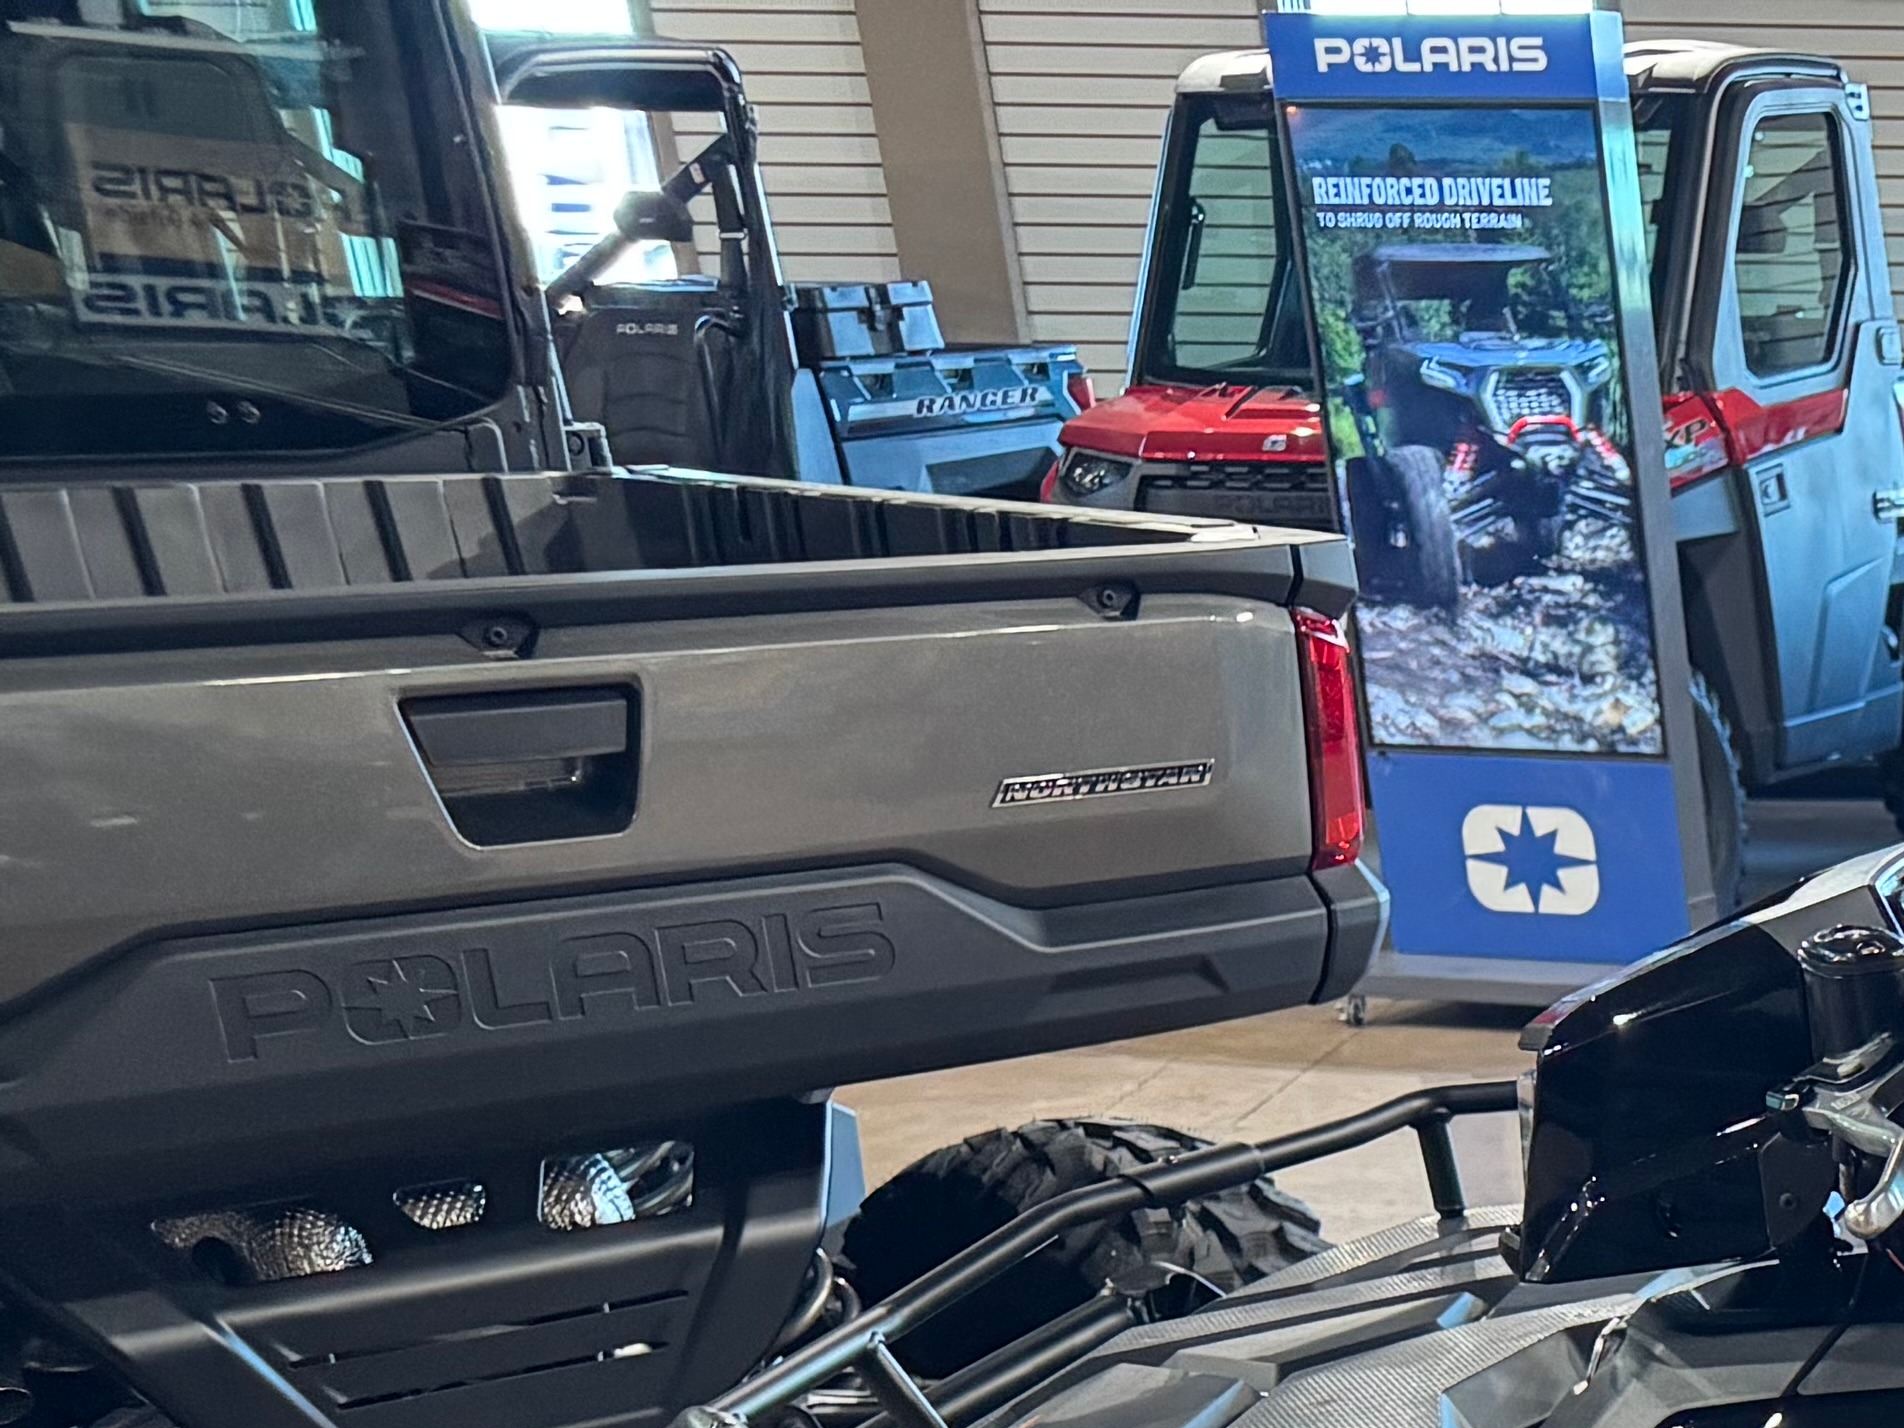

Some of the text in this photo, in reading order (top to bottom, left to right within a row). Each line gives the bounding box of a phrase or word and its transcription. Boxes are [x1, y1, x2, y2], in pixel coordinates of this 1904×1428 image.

[1315, 35, 1547, 73] POLARIS
[1312, 176, 1553, 207] REINFORCED DRIVELINE
[1316, 212, 1523, 230] TO SHRUG OFF ROUGH TERRAIN
[616, 322, 679, 337] POLARIS
[914, 385, 1041, 419] RANGER
[1005, 764, 1205, 803] NORTHSTAR
[208, 901, 898, 1064] POLARIS
